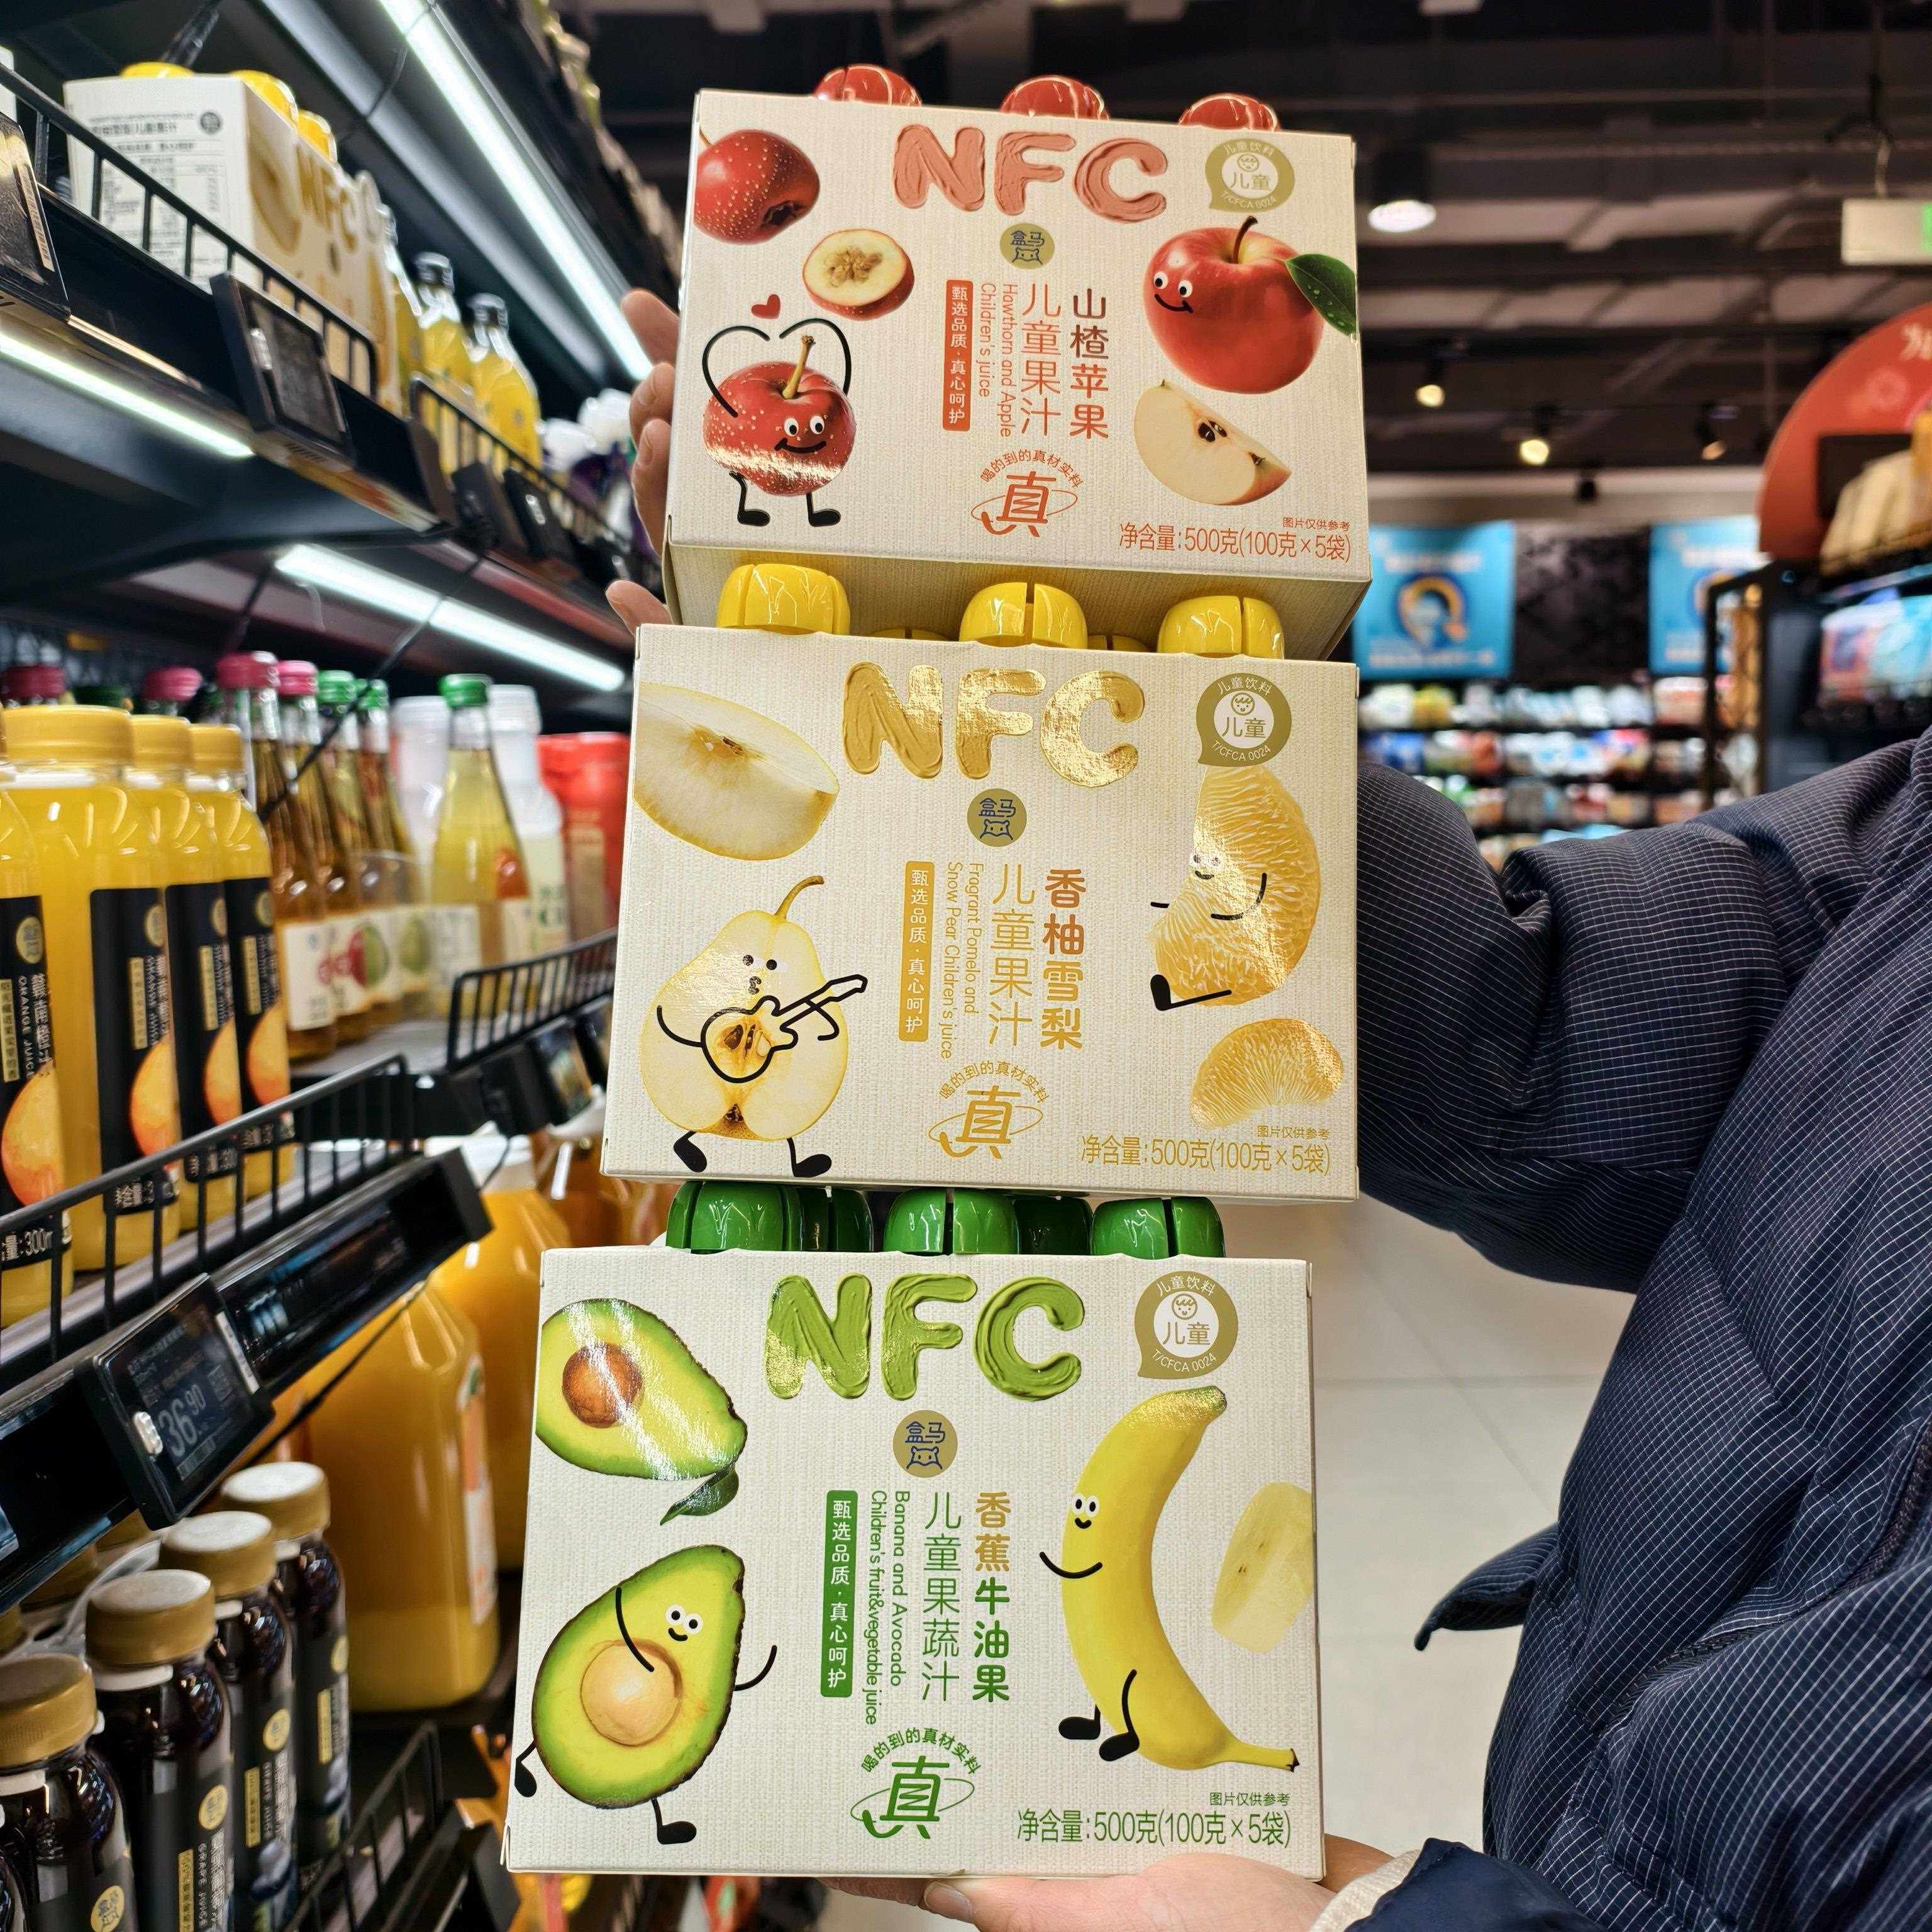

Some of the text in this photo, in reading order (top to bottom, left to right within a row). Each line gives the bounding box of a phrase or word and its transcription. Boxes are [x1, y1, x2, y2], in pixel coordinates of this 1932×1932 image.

[893, 123, 1169, 224] NFC
[1223, 141, 1275, 157] 儿童饮料
[1228, 171, 1271, 192] 儿童
[1010, 230, 1045, 247] 盒马
[948, 286, 969, 425] 甄选品质·真心呵护
[975, 283, 996, 397] Children's juice
[997, 284, 1018, 438] Hawthorn and Apple
[1020, 282, 1062, 437] 儿童果汁
[1069, 287, 1109, 440] 山楂苹果
[979, 448, 1085, 489] 喝的到的真材实料
[981, 470, 1059, 538] 真
[1282, 516, 1351, 532] 图片仅供参考
[841, 660, 1146, 788] NFC
[1214, 675, 1274, 695] 儿童饮料
[1212, 739, 1272, 763] T/CFCA 0024
[1221, 716, 1267, 740] 儿童
[979, 797, 1017, 818] 盒马
[905, 869, 929, 1033] 甄选品质·真心呵护
[938, 861, 963, 1060] Snow Pear Children's juice
[963, 862, 984, 1014] Fragrant Pomelo and
[988, 863, 1035, 1047] 儿童果汁
[1040, 868, 1087, 1050] 香柚雪梨
[938, 1060, 1050, 1105] 喝的到的真材实料
[940, 1085, 1021, 1160] 真
[1257, 1124, 1331, 1140] 图片仅供参考
[1156, 1275, 1217, 1298] 儿童饮料
[764, 1272, 1085, 1402] NFC
[1152, 1348, 1218, 1374] T/CFCA 0024
[1161, 1321, 1211, 1347] 儿童
[904, 1420, 946, 1444] 盒马
[828, 1499, 852, 1689] 甄选品质·真心呵护
[862, 1490, 887, 1725] Children's fruit&vegetable juice
[890, 1491, 911, 1687] Banana and Avocado
[922, 1491, 962, 1702] 儿童果蔬汁
[972, 1491, 1012, 1703] 香蕉牛油果
[860, 1726, 981, 1775] 喝的到的真材实料
[862, 1755, 951, 1840] 真
[1209, 1791, 1290, 1807] 图片仅供参考
